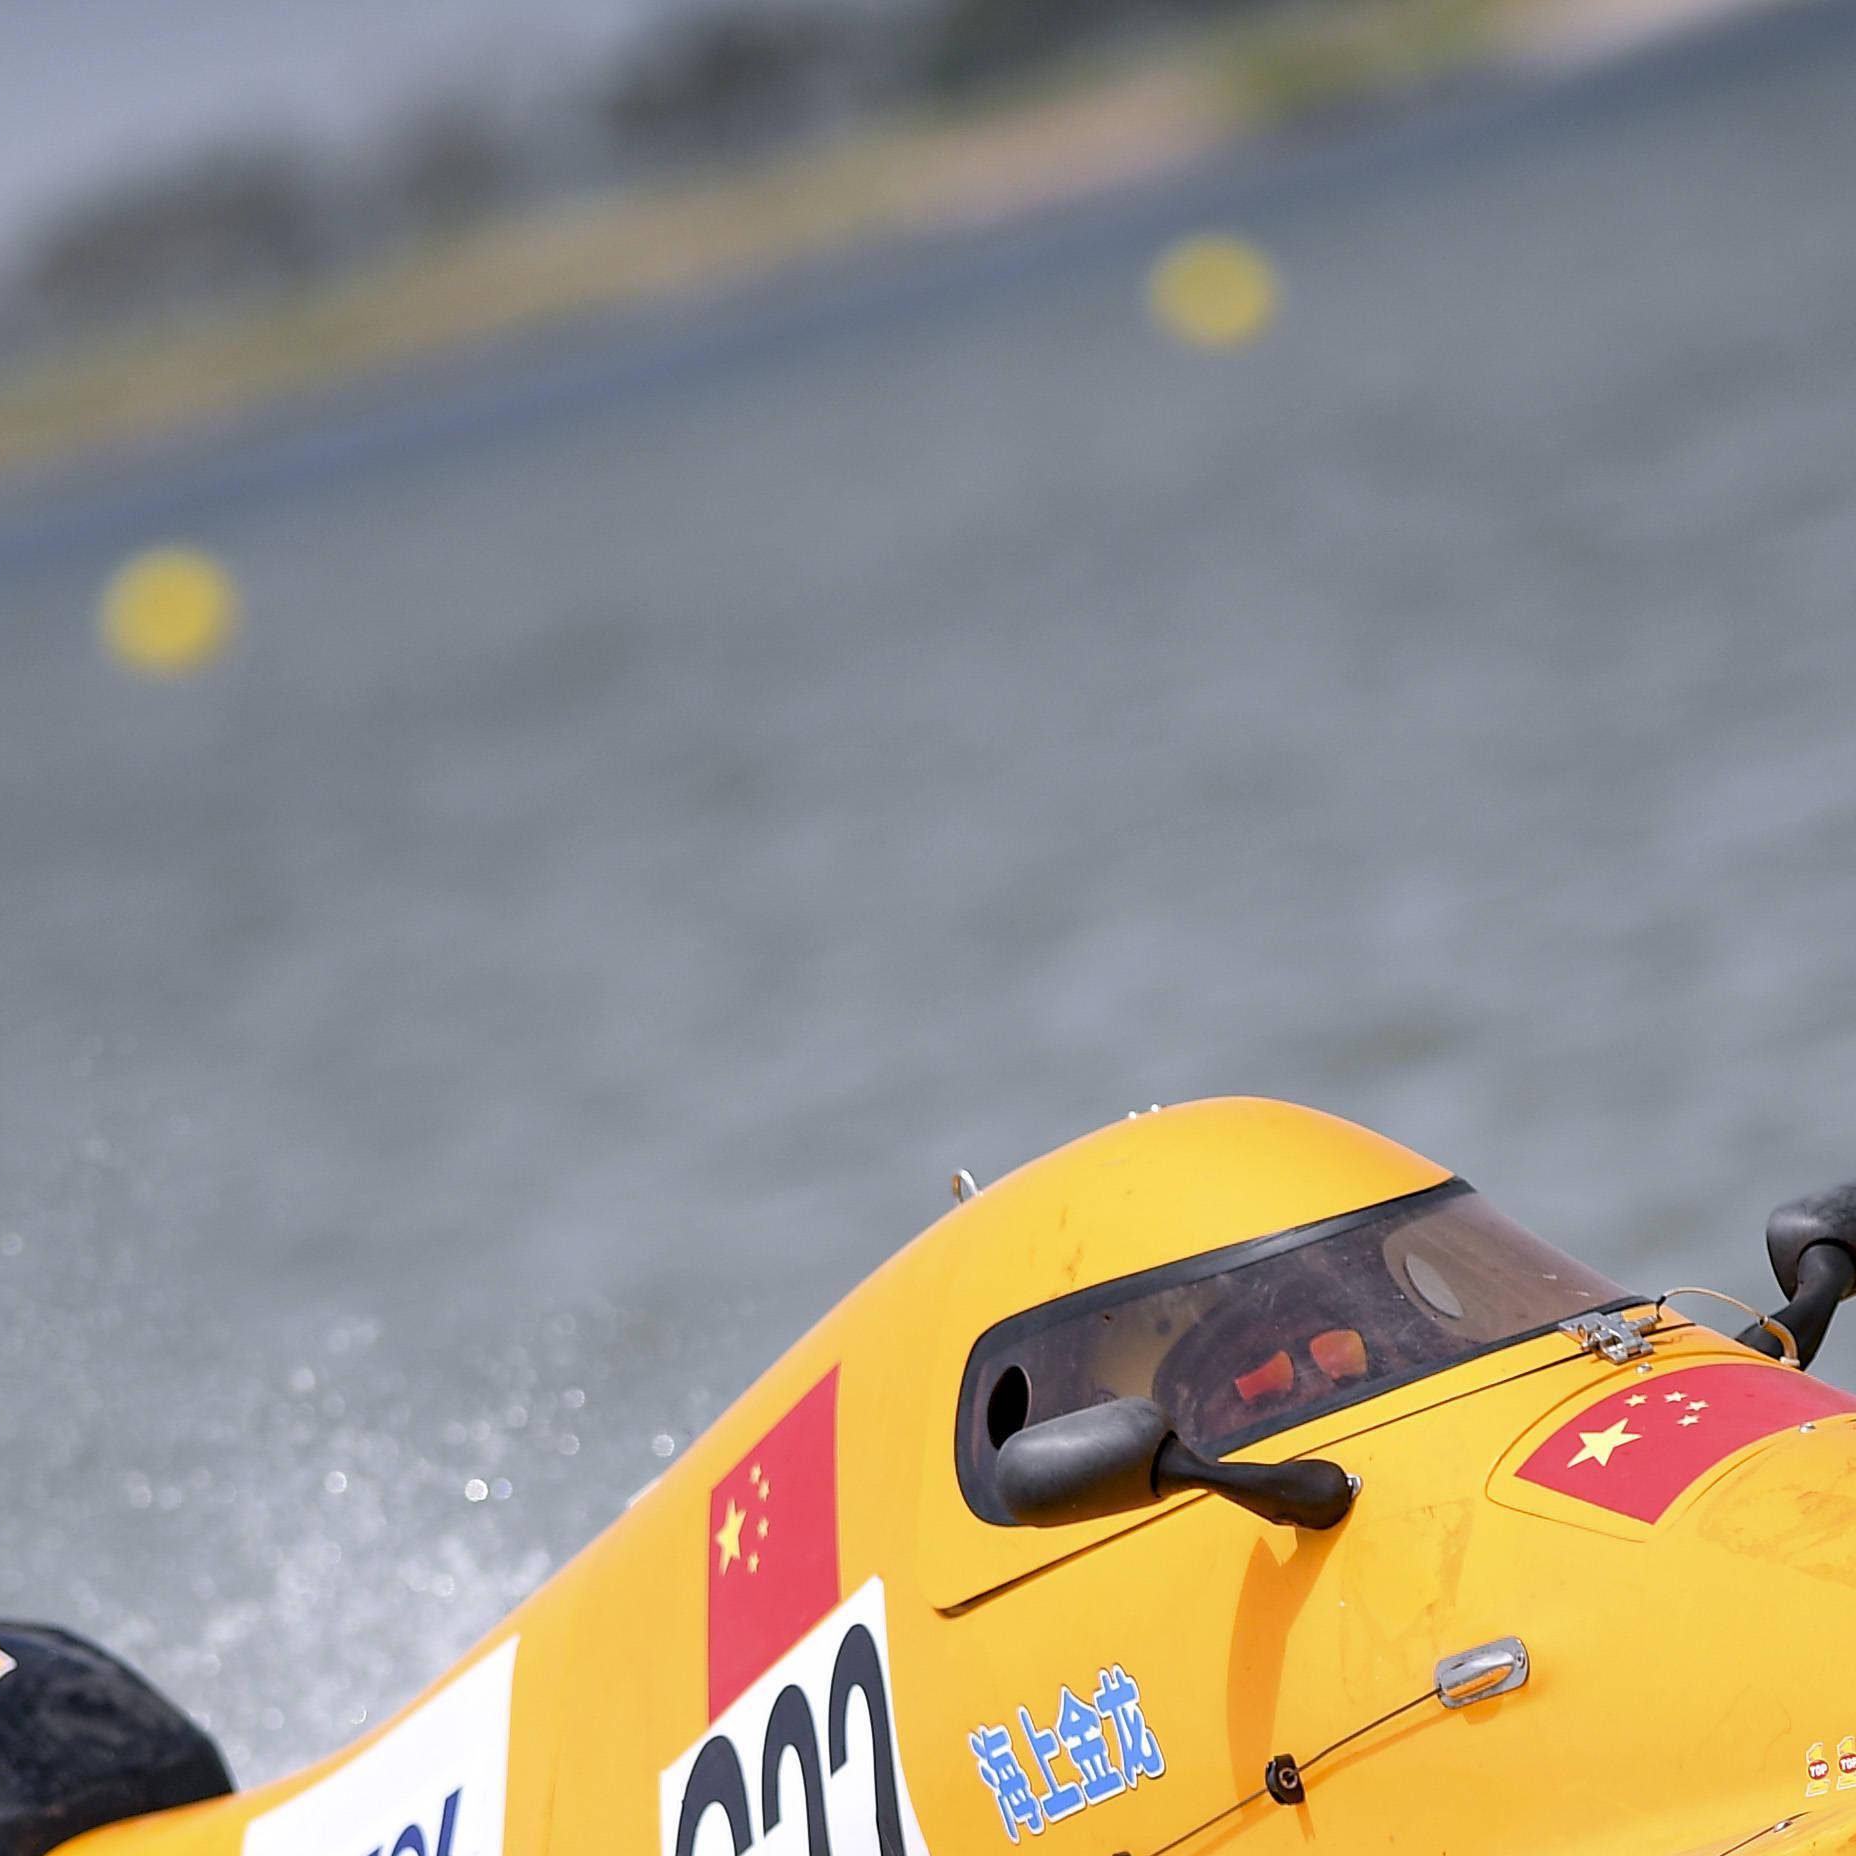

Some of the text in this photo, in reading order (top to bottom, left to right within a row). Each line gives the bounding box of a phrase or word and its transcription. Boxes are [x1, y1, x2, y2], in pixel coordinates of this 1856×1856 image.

[969, 1662, 1166, 1845] 海上金龙
[1809, 1763, 1828, 1777] TOP
